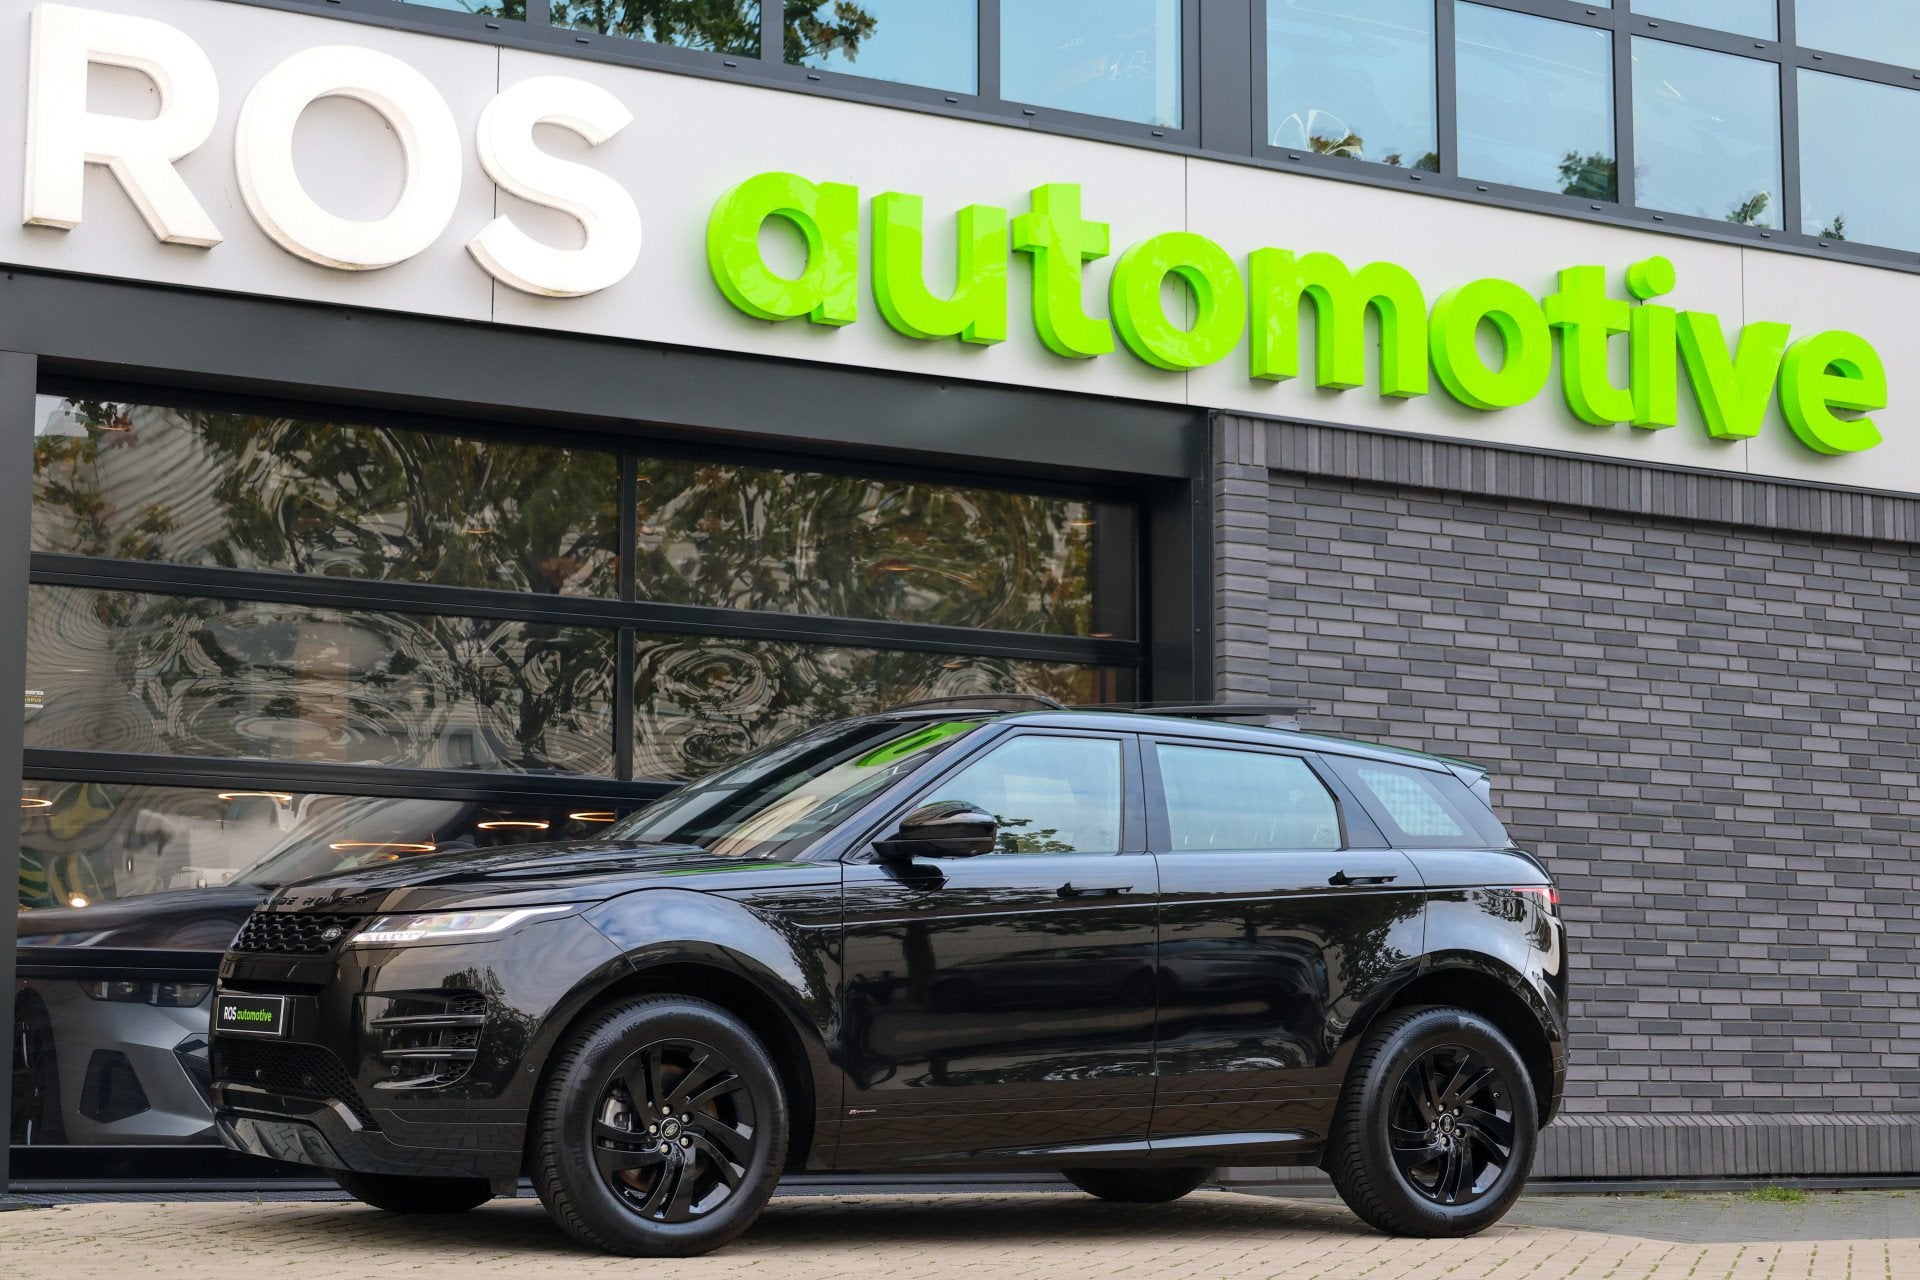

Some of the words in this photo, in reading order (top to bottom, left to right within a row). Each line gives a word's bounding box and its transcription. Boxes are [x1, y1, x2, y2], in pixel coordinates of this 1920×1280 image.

[22, 2, 642, 298] ROS
[706, 171, 1888, 456] automotive
[224, 1006, 237, 1020] ROS
[237, 1009, 272, 1022] automotive
